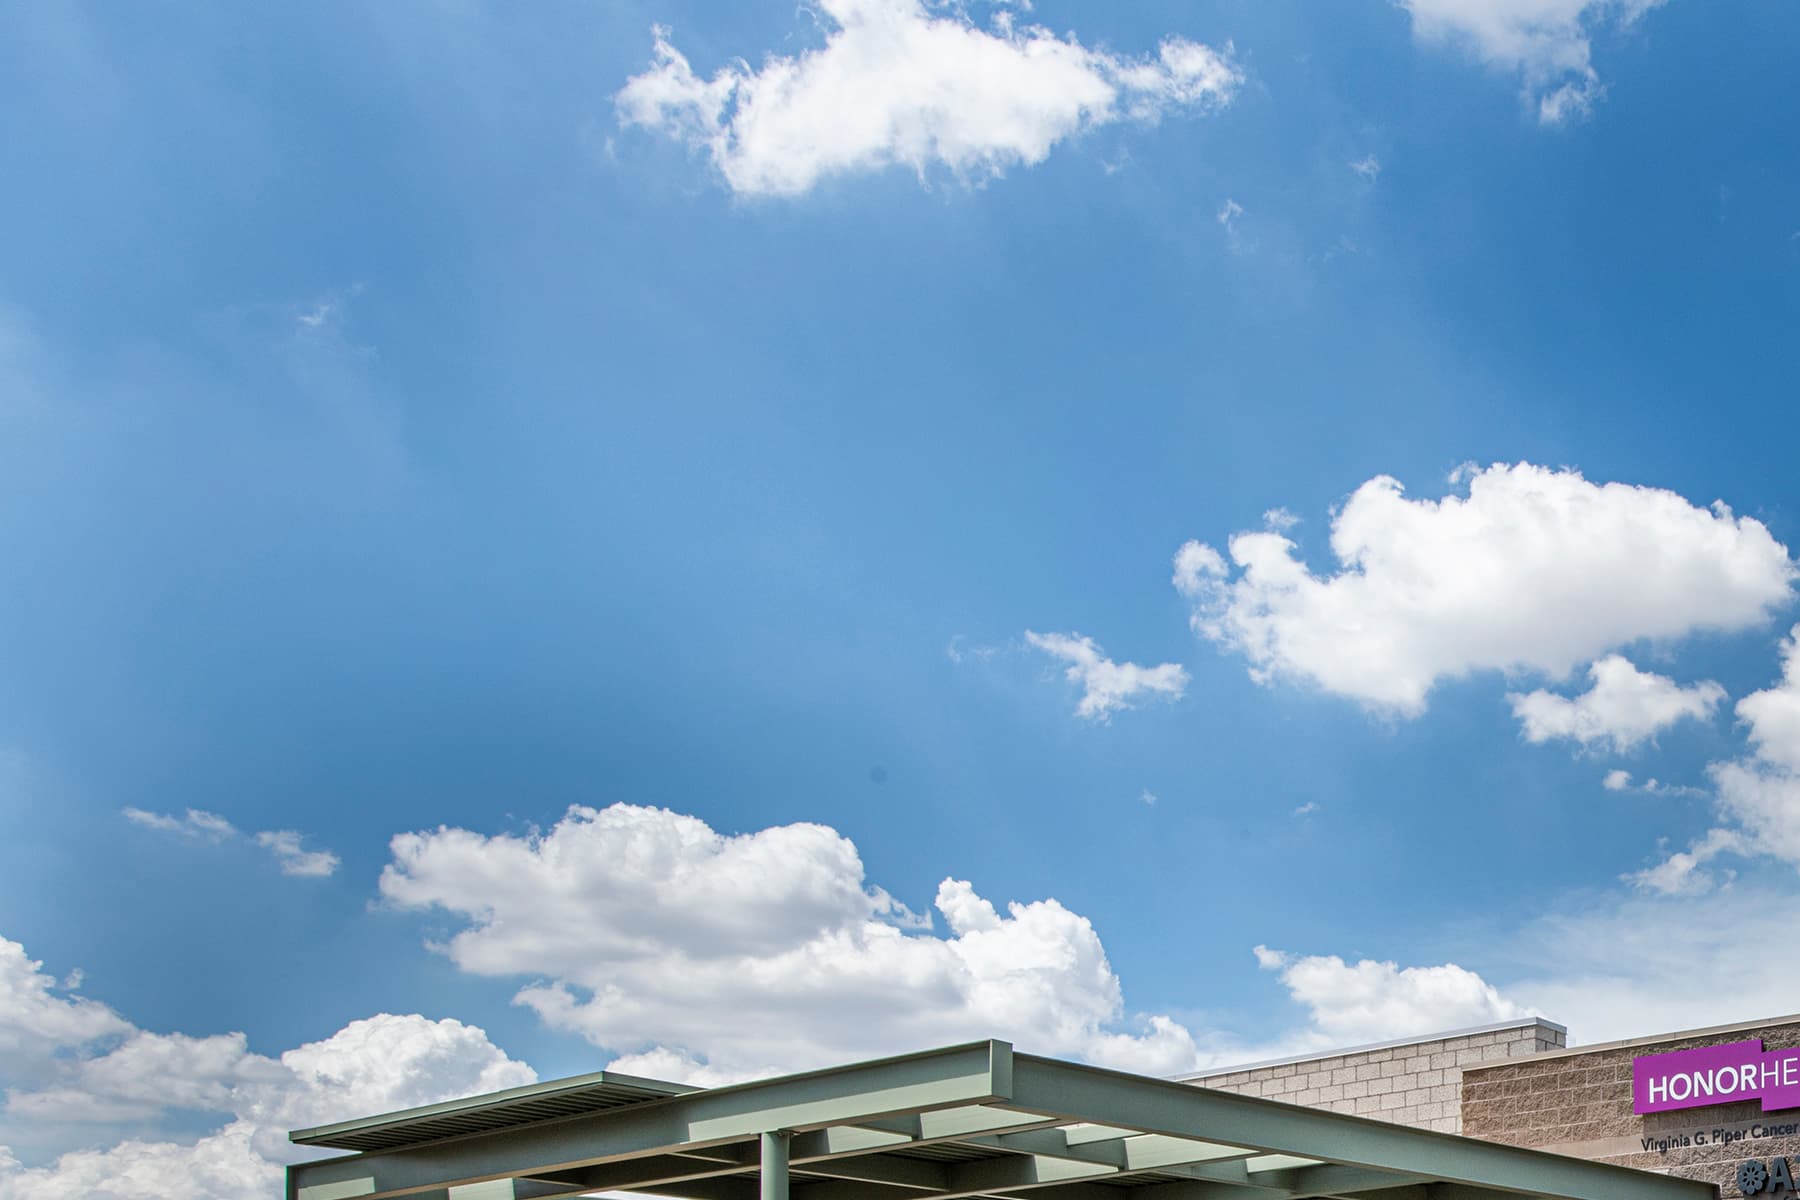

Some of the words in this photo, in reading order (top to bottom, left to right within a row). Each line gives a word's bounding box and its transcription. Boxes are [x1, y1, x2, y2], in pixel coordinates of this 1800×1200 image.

[1641, 1134, 1690, 1153] Virginia
[1694, 1131, 1708, 1145] G.
[1712, 1128, 1747, 1146] Piper
[1751, 1122, 1799, 1139] Cancer
